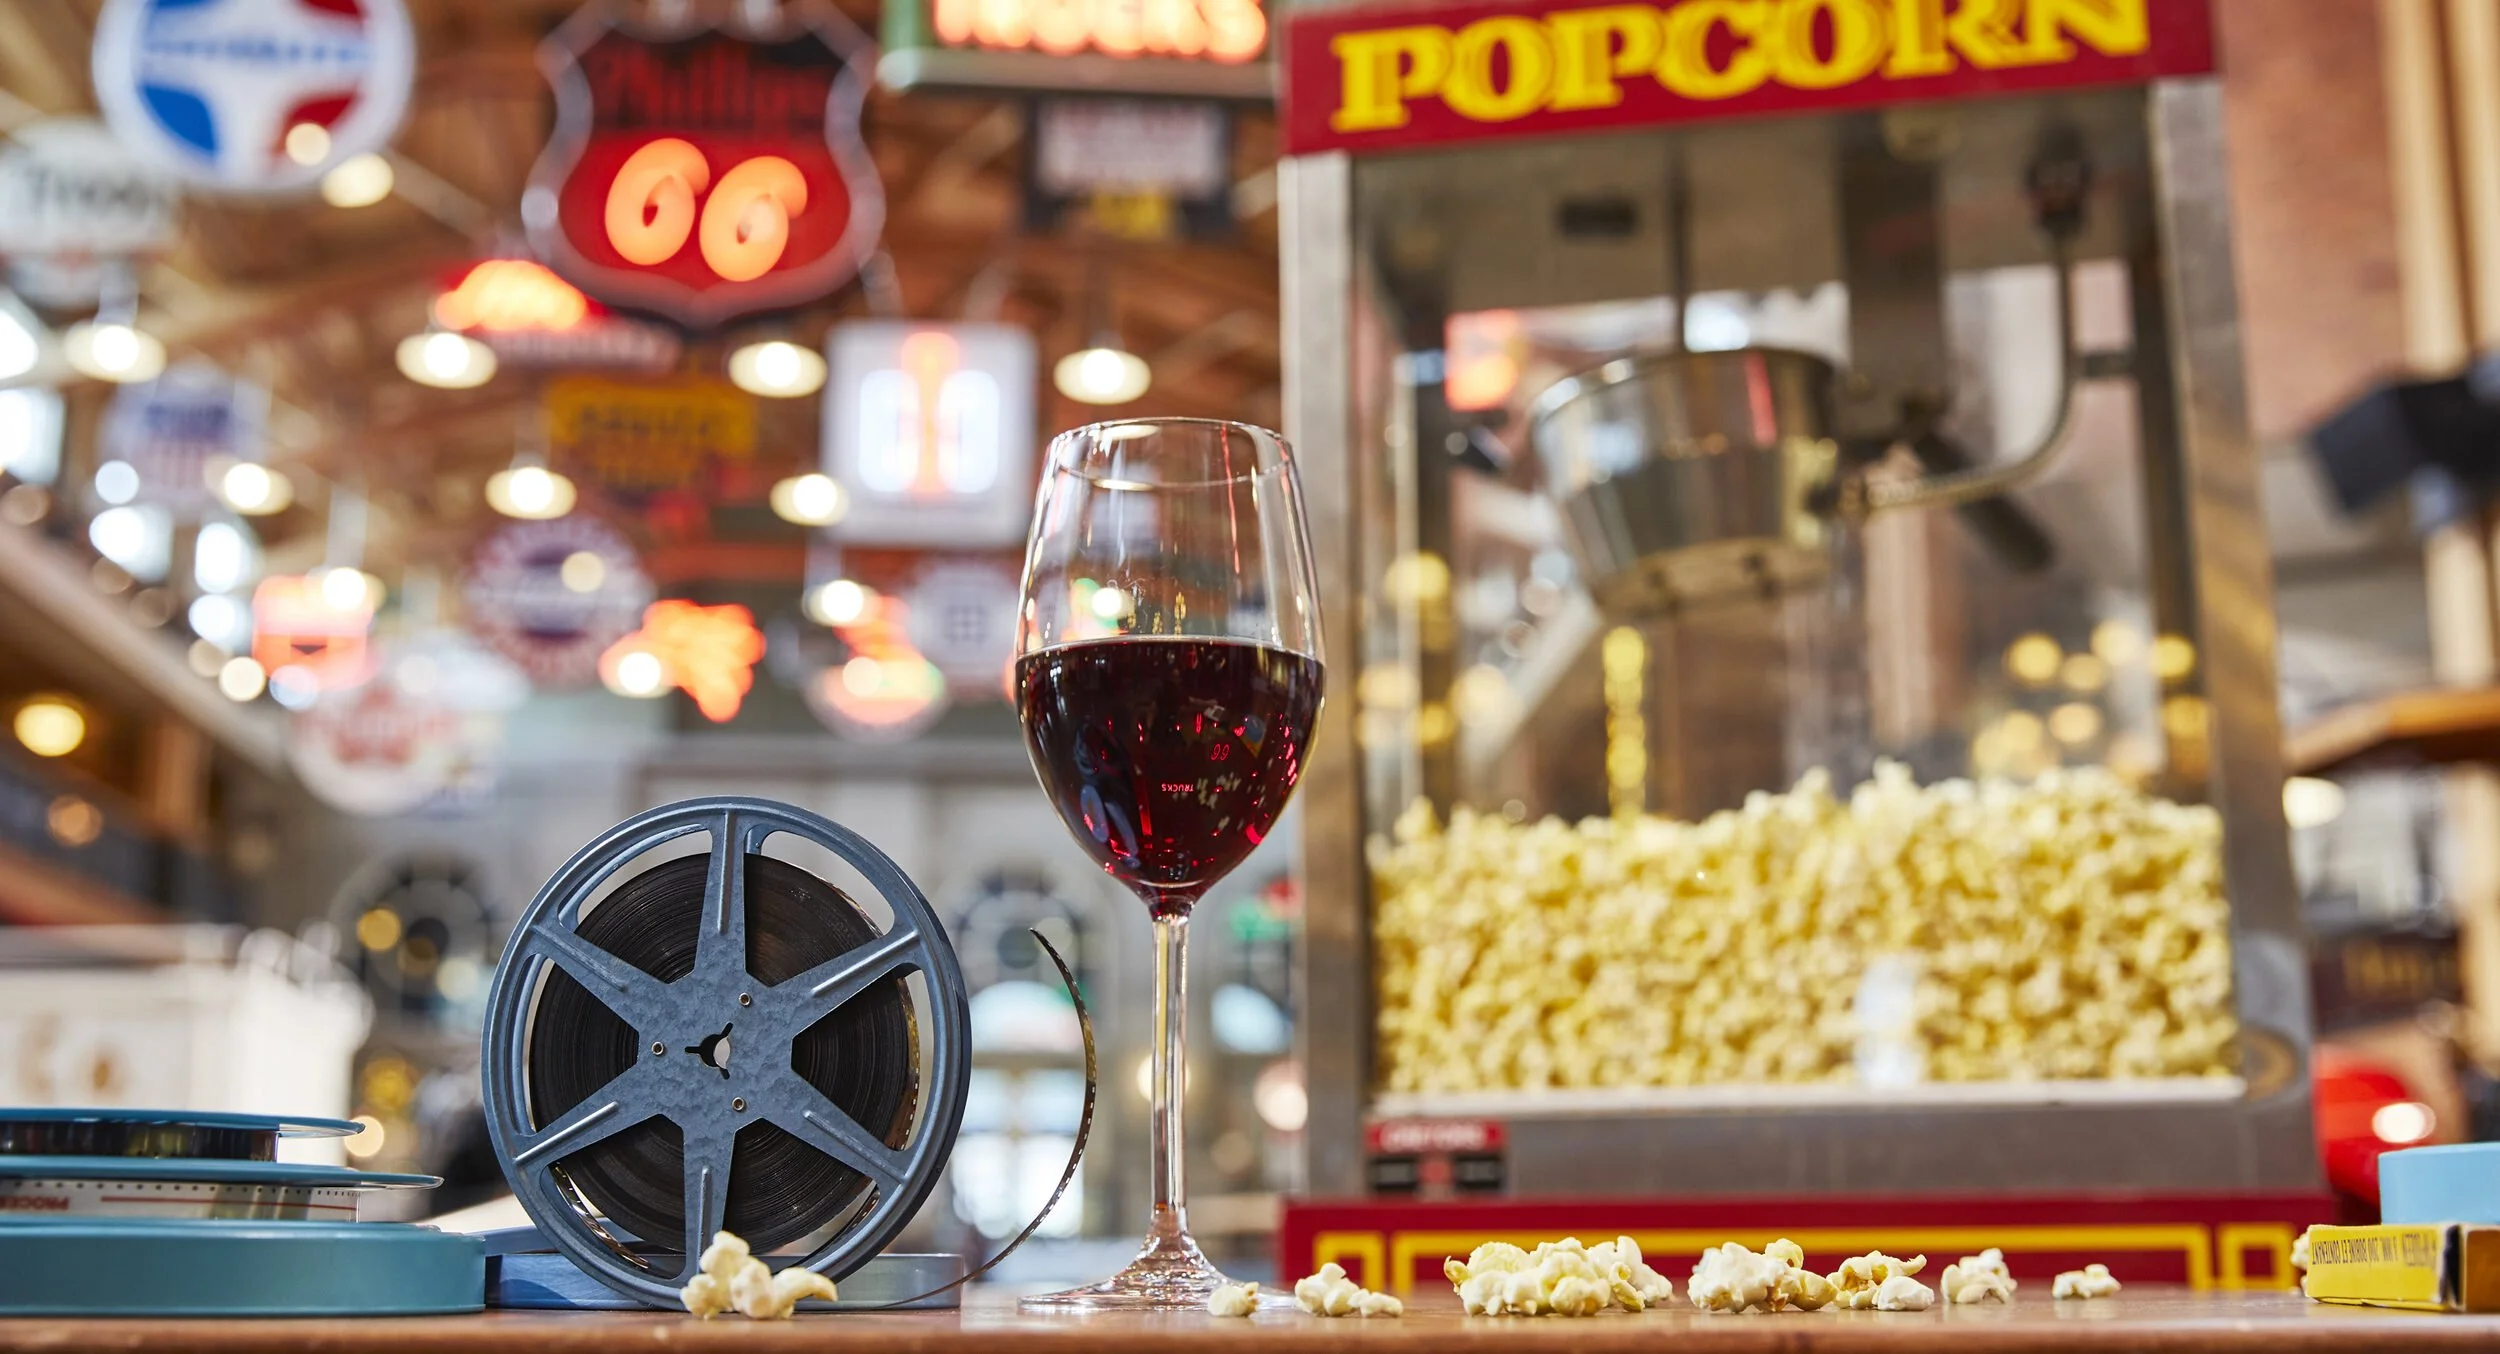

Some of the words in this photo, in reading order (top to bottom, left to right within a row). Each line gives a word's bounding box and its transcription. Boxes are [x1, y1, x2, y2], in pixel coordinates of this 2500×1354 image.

[1331, 0, 2150, 132] POPCORN
[604, 137, 808, 282] 66
[1161, 783, 1194, 792] TRUCKS
[2311, 1240, 2341, 1265] CONTENANT
